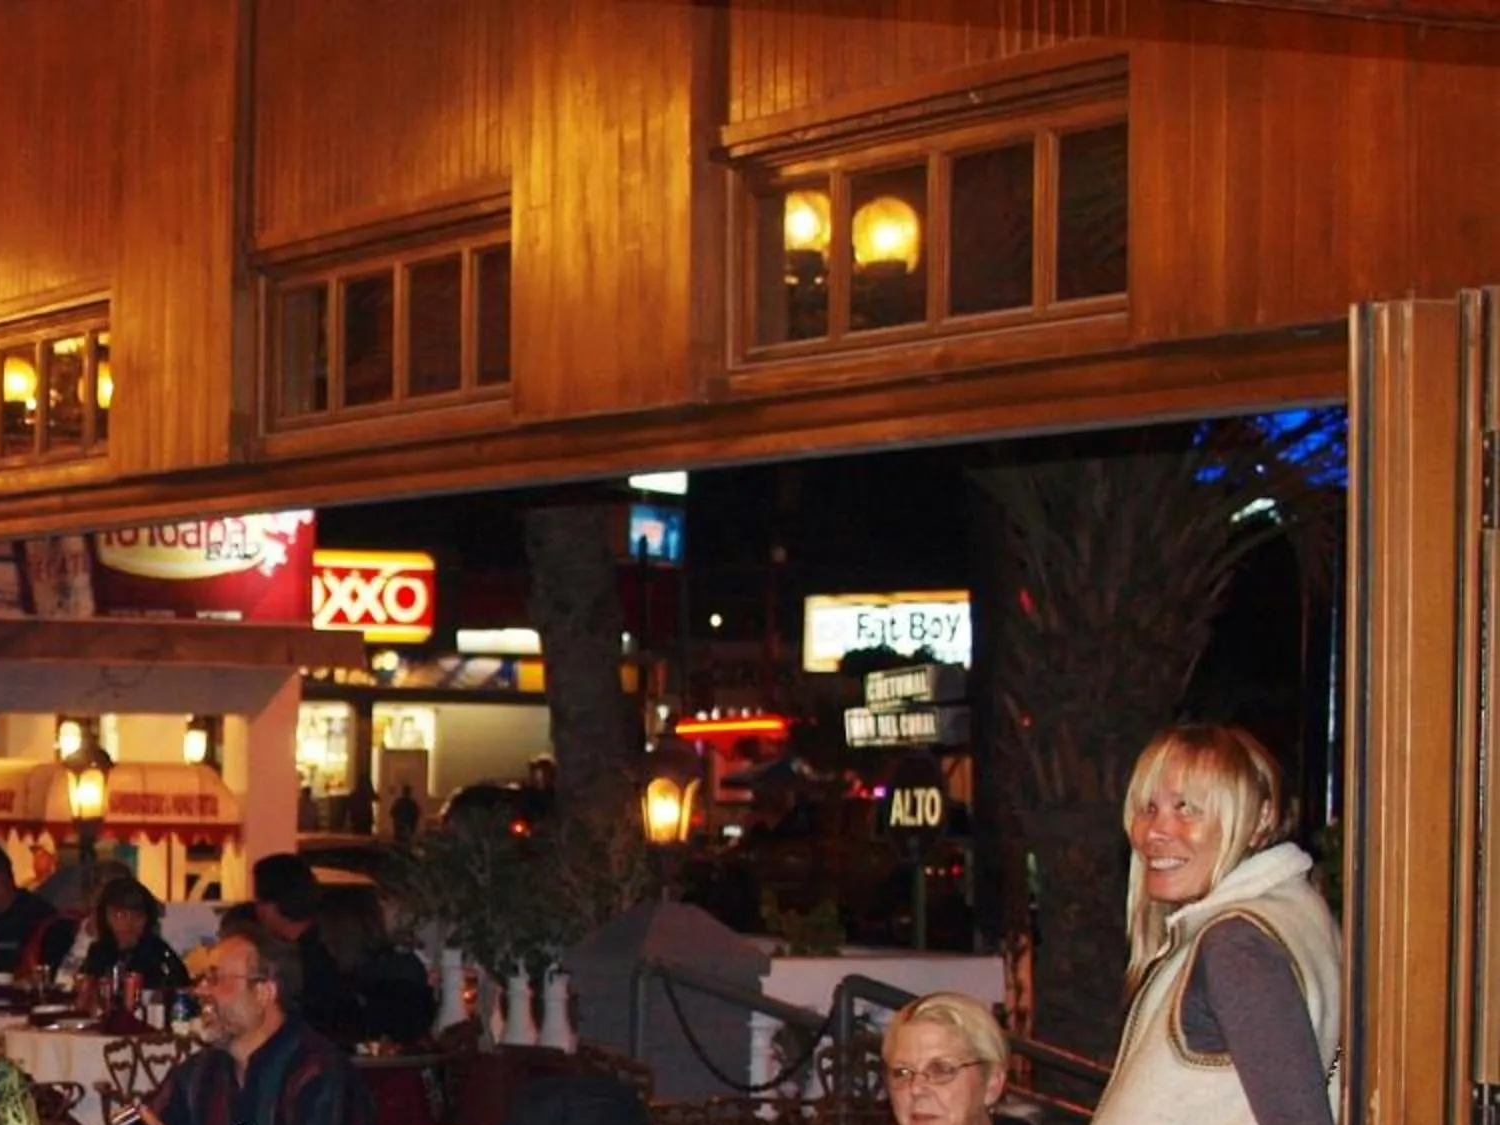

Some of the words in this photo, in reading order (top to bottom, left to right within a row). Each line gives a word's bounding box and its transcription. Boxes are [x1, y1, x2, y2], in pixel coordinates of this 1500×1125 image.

[312, 567, 428, 624] XXO
[908, 612, 961, 642] Boy
[890, 787, 941, 826] ALTO
